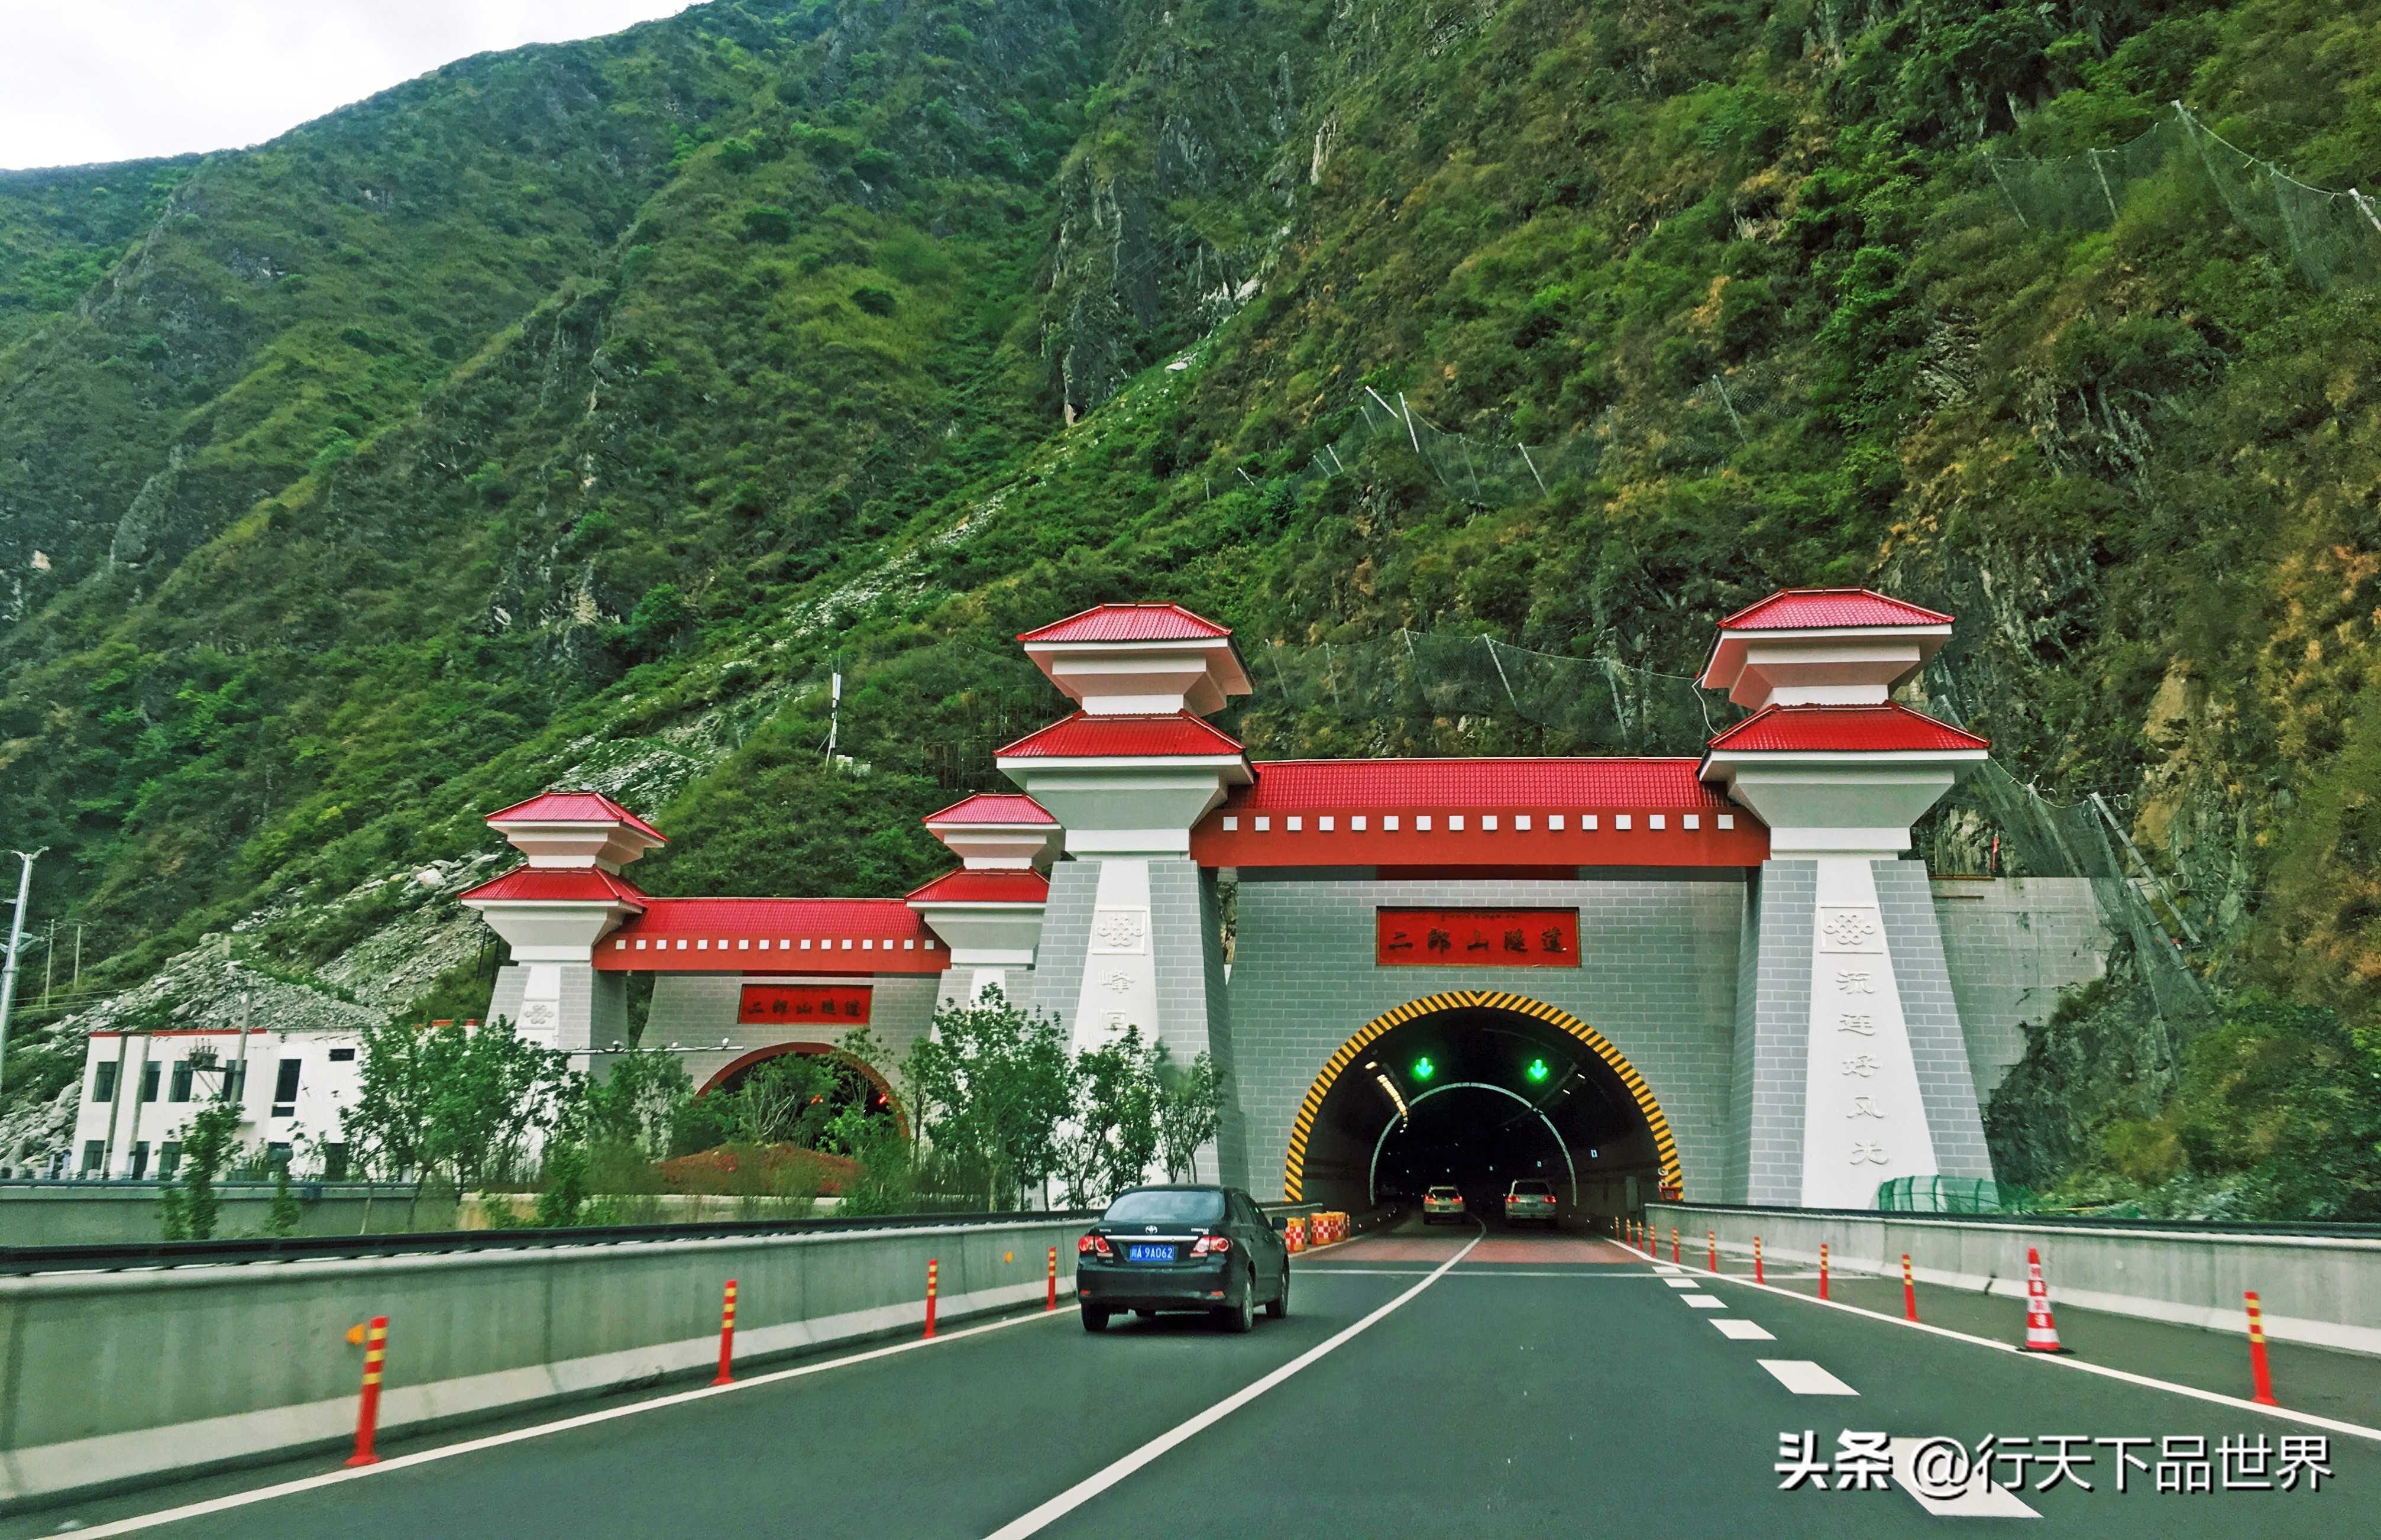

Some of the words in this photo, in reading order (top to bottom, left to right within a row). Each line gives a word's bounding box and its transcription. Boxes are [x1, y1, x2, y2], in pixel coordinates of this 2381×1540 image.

[1835, 969, 1890, 1166] 流连好风光
